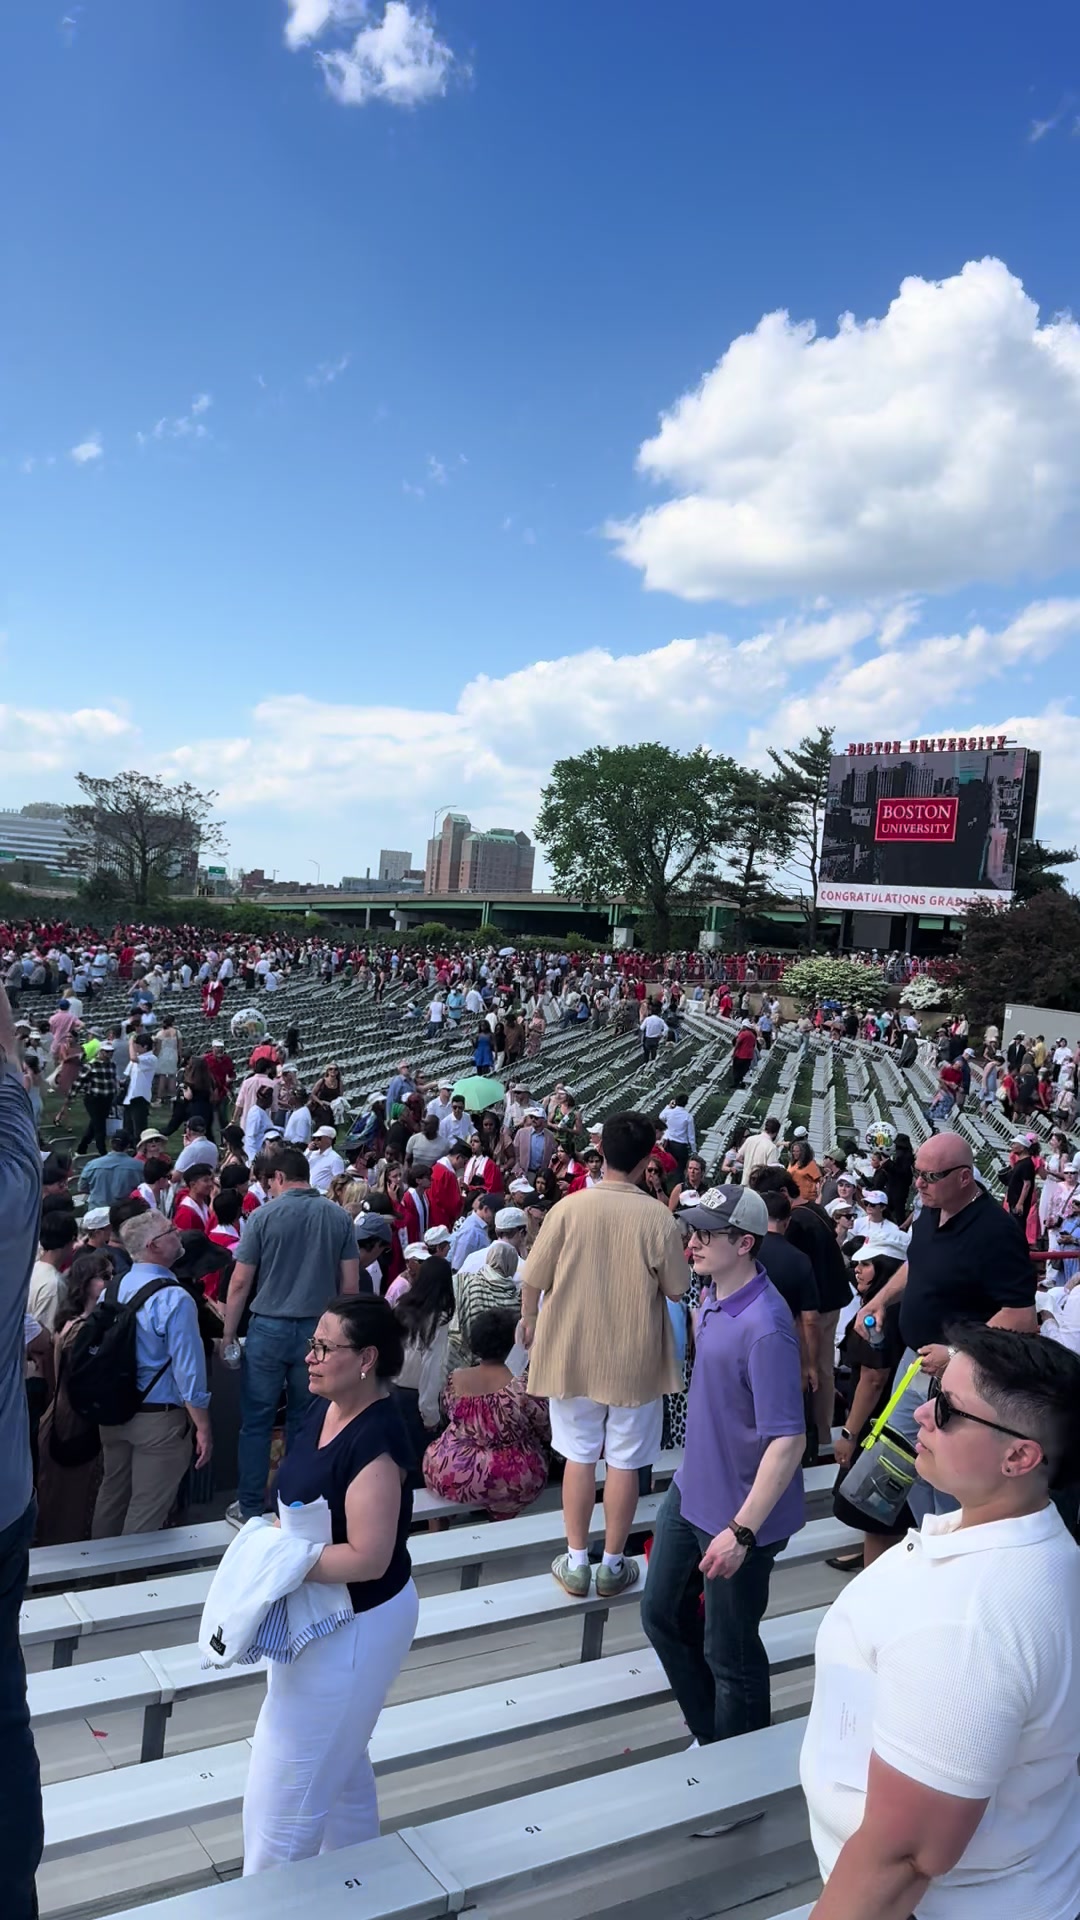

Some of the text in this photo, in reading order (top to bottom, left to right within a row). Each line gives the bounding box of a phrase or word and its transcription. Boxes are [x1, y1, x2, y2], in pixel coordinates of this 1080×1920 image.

[848, 735, 1007, 756] BOSTON UNIVERSITY
[882, 804, 952, 820] BOSTON
[881, 823, 951, 834] UNIVERSITY
[820, 890, 926, 906] CONGRATULATIONS
[686, 1776, 700, 1787] 17
[525, 1825, 542, 1834] 16
[344, 1878, 362, 1889] 15
